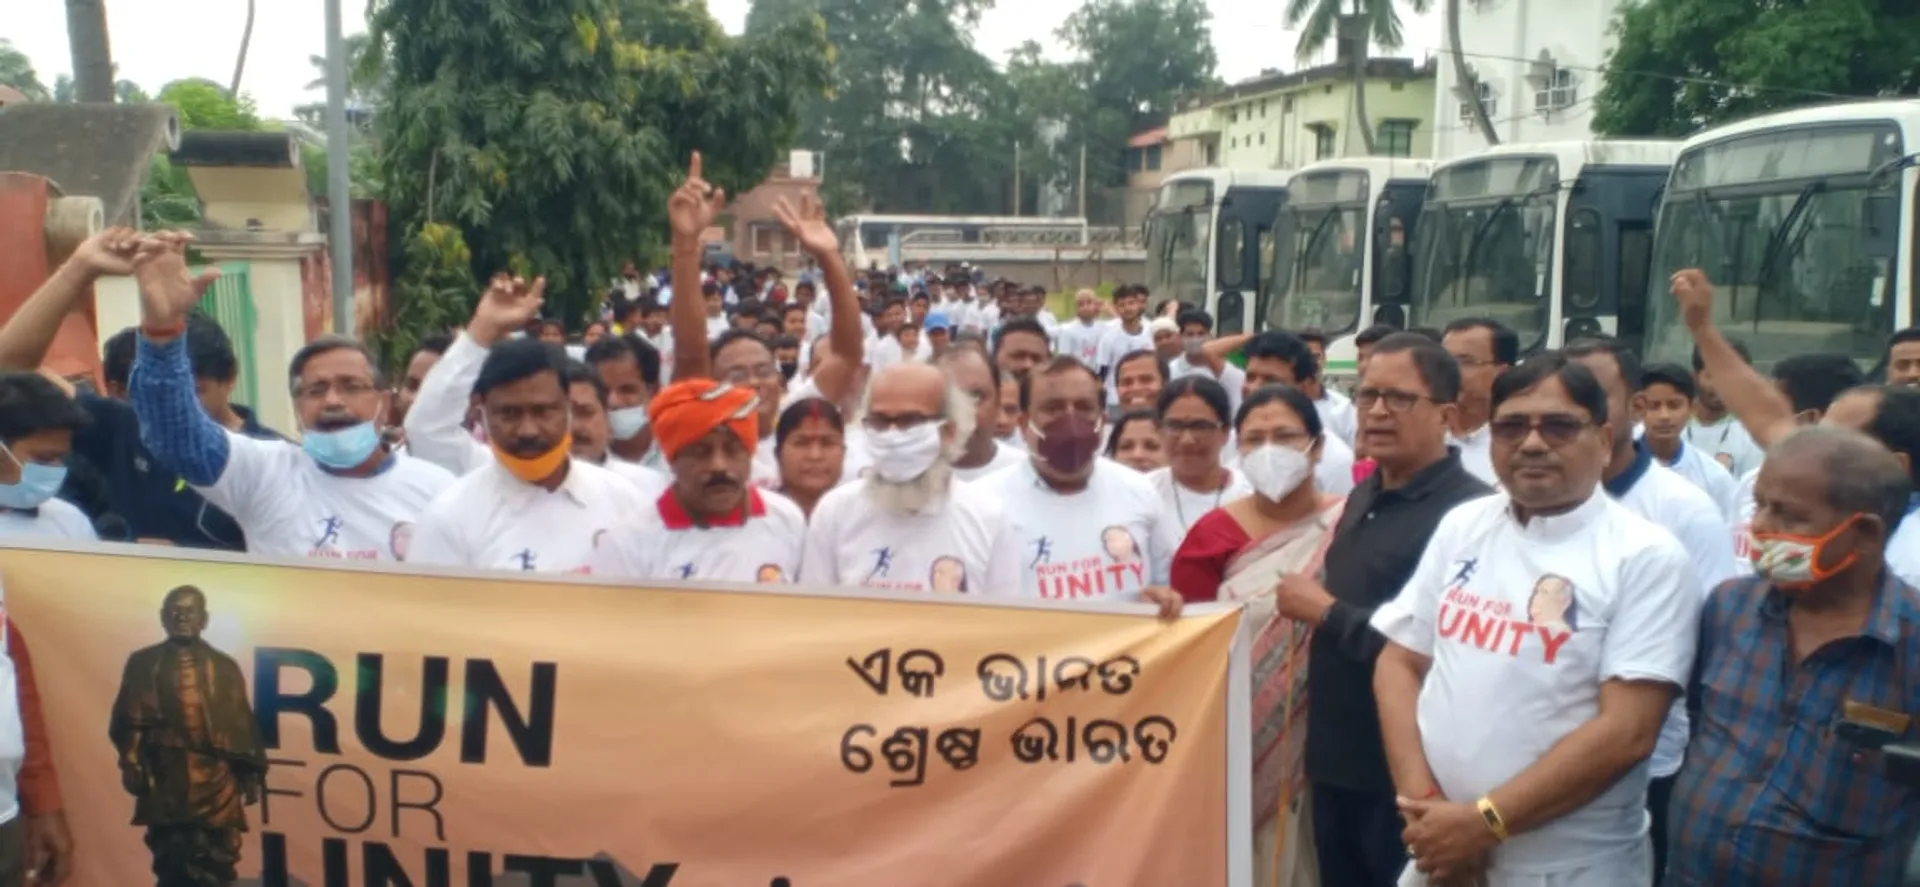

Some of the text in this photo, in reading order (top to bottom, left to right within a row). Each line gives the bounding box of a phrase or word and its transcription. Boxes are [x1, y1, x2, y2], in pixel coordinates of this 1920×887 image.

[1038, 563, 1144, 600] UNITY
[1446, 587, 1512, 614] RUN FOR
[1438, 603, 1572, 664] UNITY
[846, 648, 945, 698] ଏକ
[254, 647, 558, 768] RUN
[1010, 715, 1177, 764] ଭାରତ
[260, 758, 447, 841] FOR
[261, 831, 682, 887] UNT
